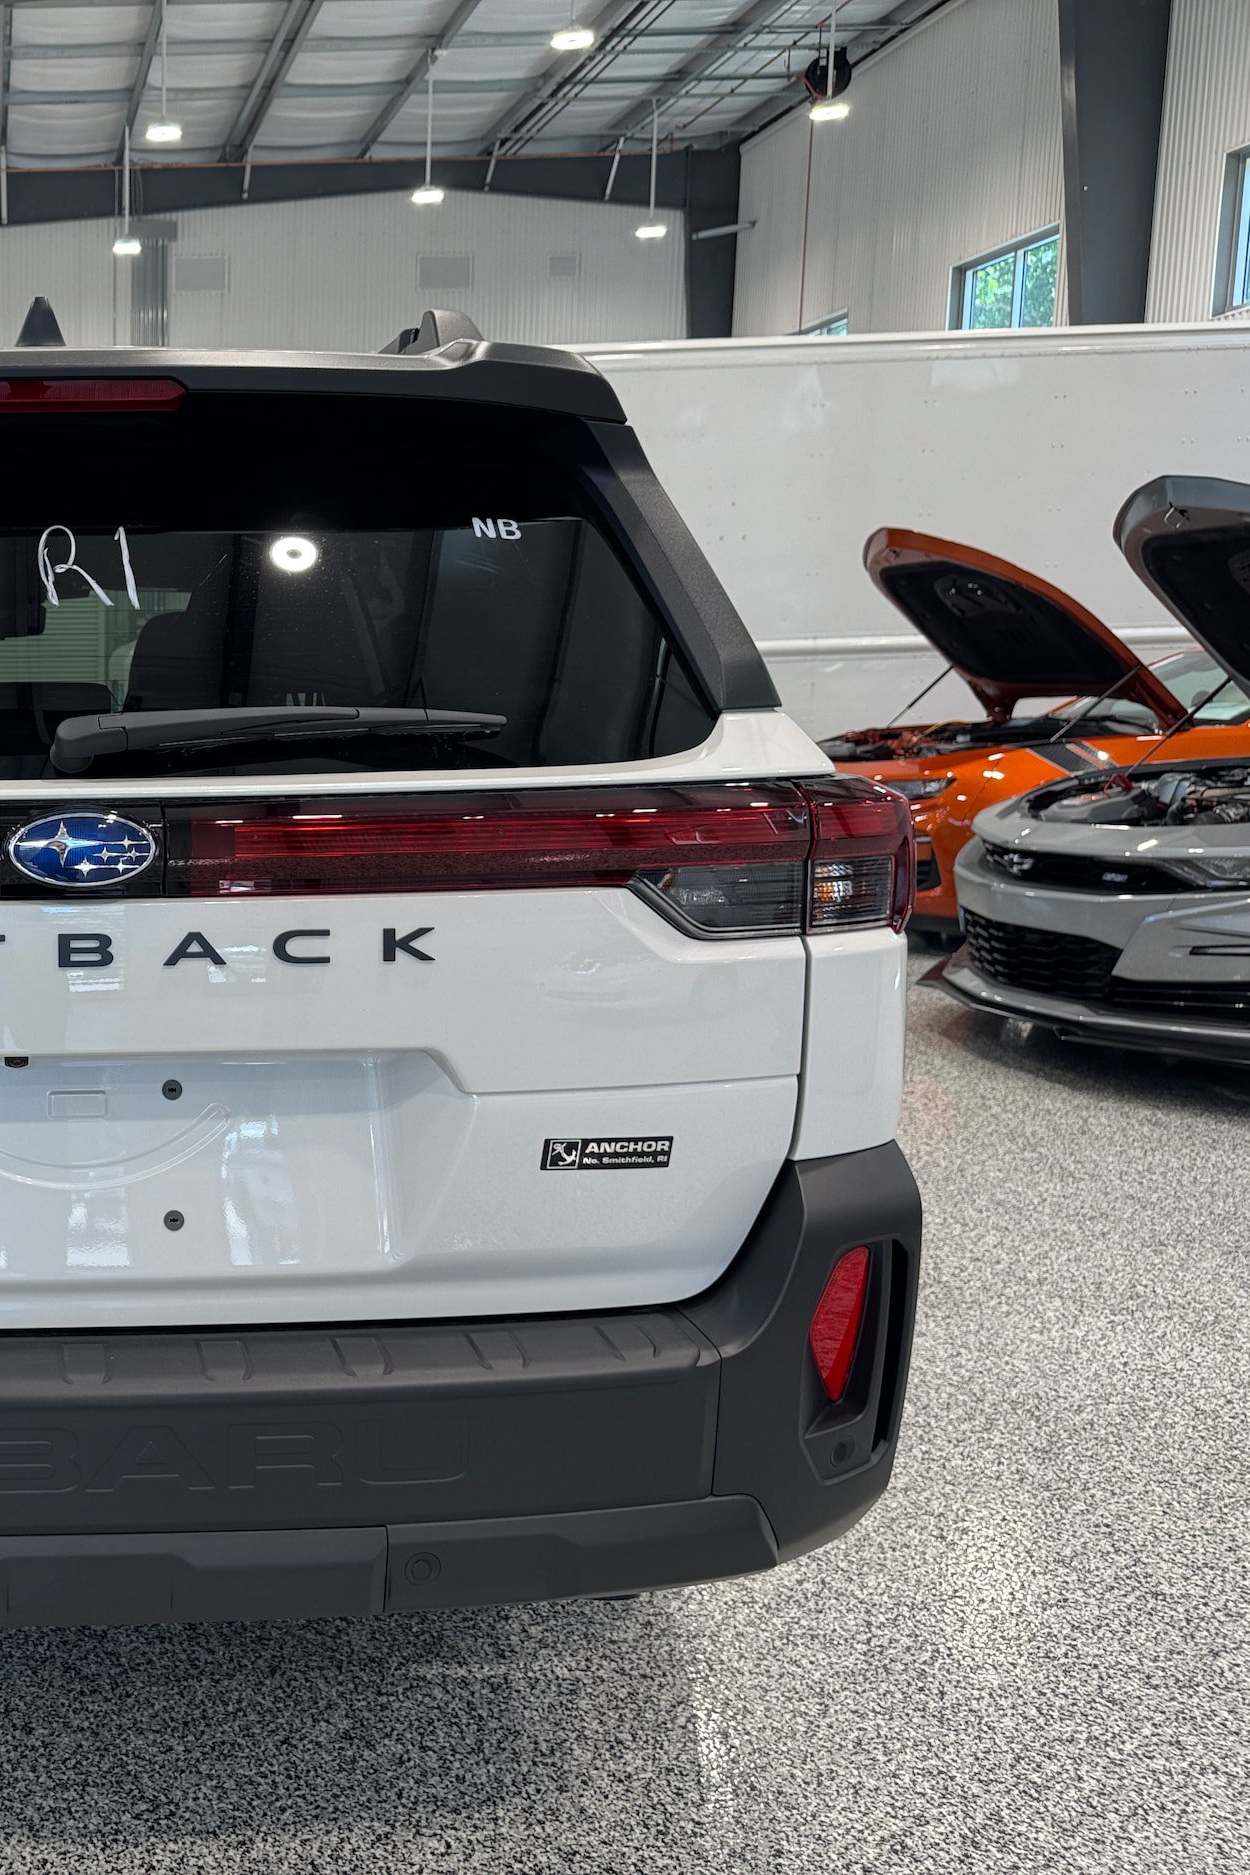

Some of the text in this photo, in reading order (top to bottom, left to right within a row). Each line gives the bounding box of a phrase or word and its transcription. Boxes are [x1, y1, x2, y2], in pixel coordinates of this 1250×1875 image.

[471, 517, 522, 540] NB
[37, 524, 141, 610] R1
[585, 1141, 670, 1153] ANCHOR
[582, 1155, 668, 1164] No. Smithfield, RI
